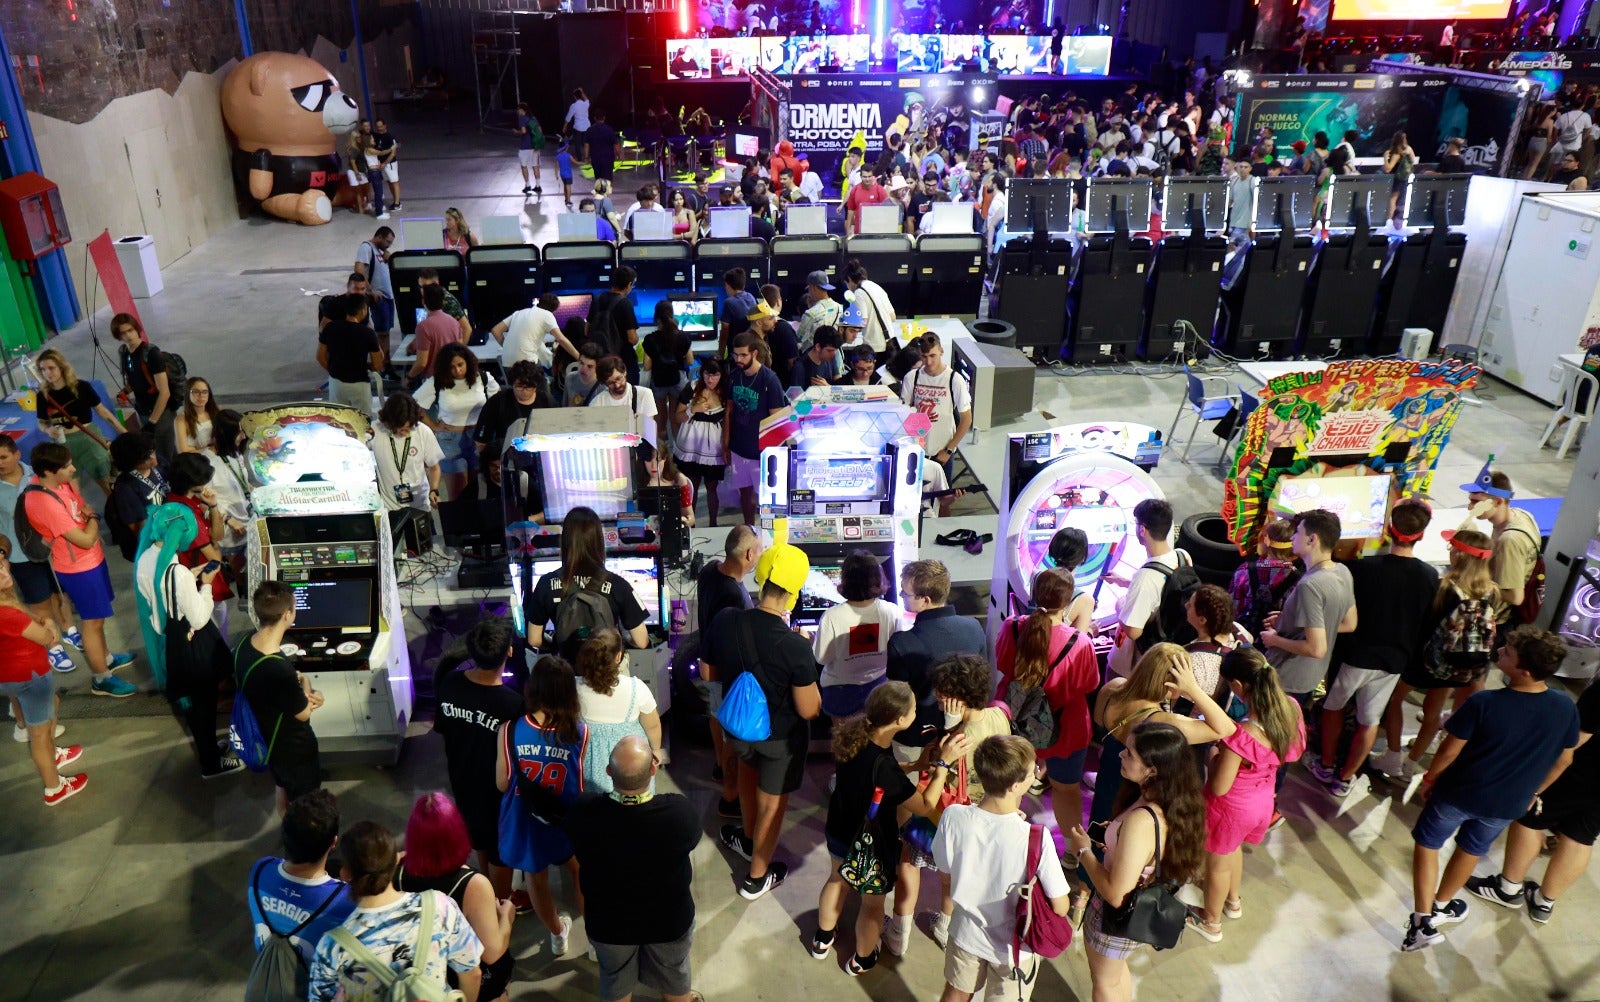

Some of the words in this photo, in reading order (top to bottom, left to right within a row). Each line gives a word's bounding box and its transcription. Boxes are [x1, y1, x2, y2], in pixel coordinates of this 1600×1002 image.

[789, 103, 882, 128] ORMENTA
[1259, 113, 1298, 121] NORMAS
[1273, 122, 1301, 130] JUEGO
[1317, 435, 1370, 449] CHANNEL
[846, 464, 873, 473] DIVA
[550, 578, 563, 590] THE
[441, 702, 473, 723] Thug
[476, 710, 500, 732] Lif
[517, 744, 541, 756] NEW
[545, 745, 571, 761] YORK
[261, 896, 311, 923] SERGIO
